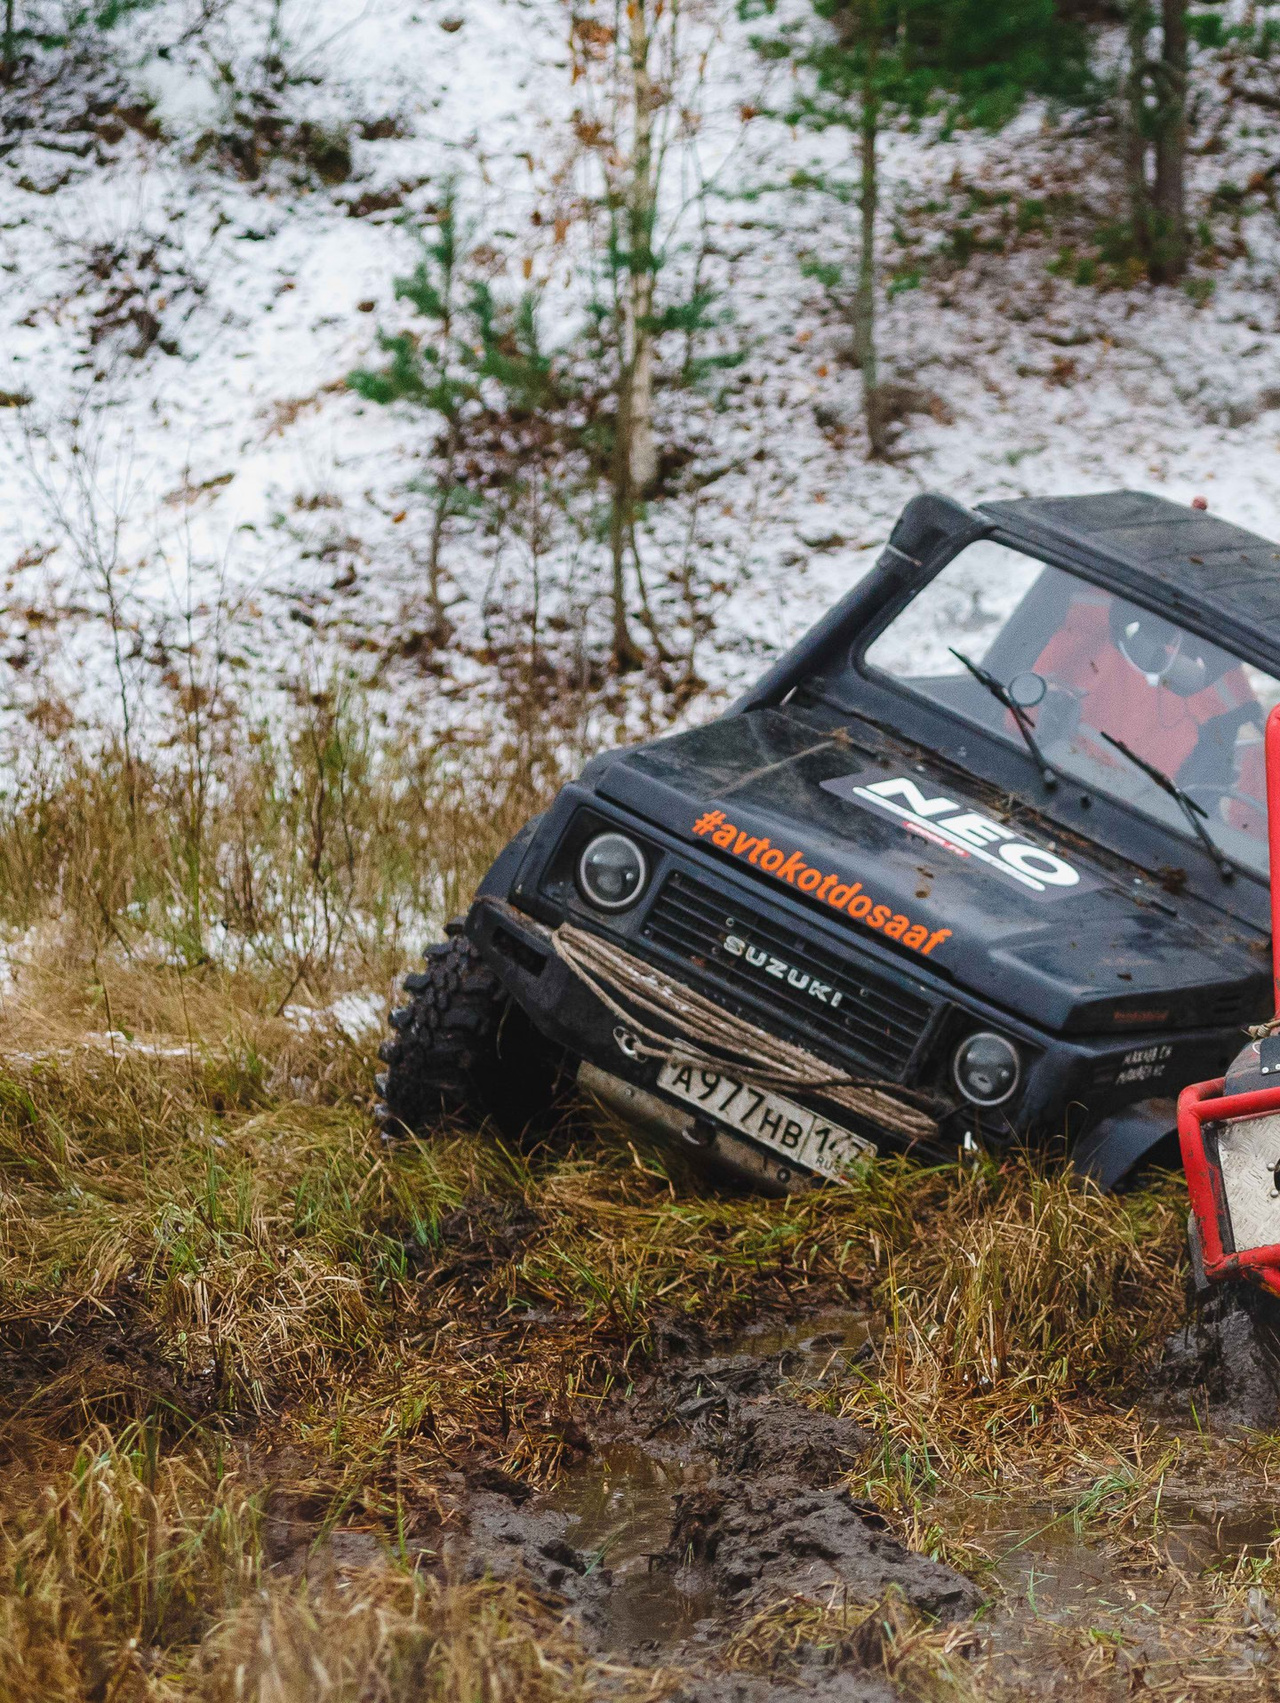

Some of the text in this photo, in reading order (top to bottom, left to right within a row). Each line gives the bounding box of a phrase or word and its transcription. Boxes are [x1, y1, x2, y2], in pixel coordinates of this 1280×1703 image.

[691, 810, 953, 956] #avtokotdosaaf
[865, 776, 1081, 887] NEO
[723, 935, 843, 1008] SUZUKI
